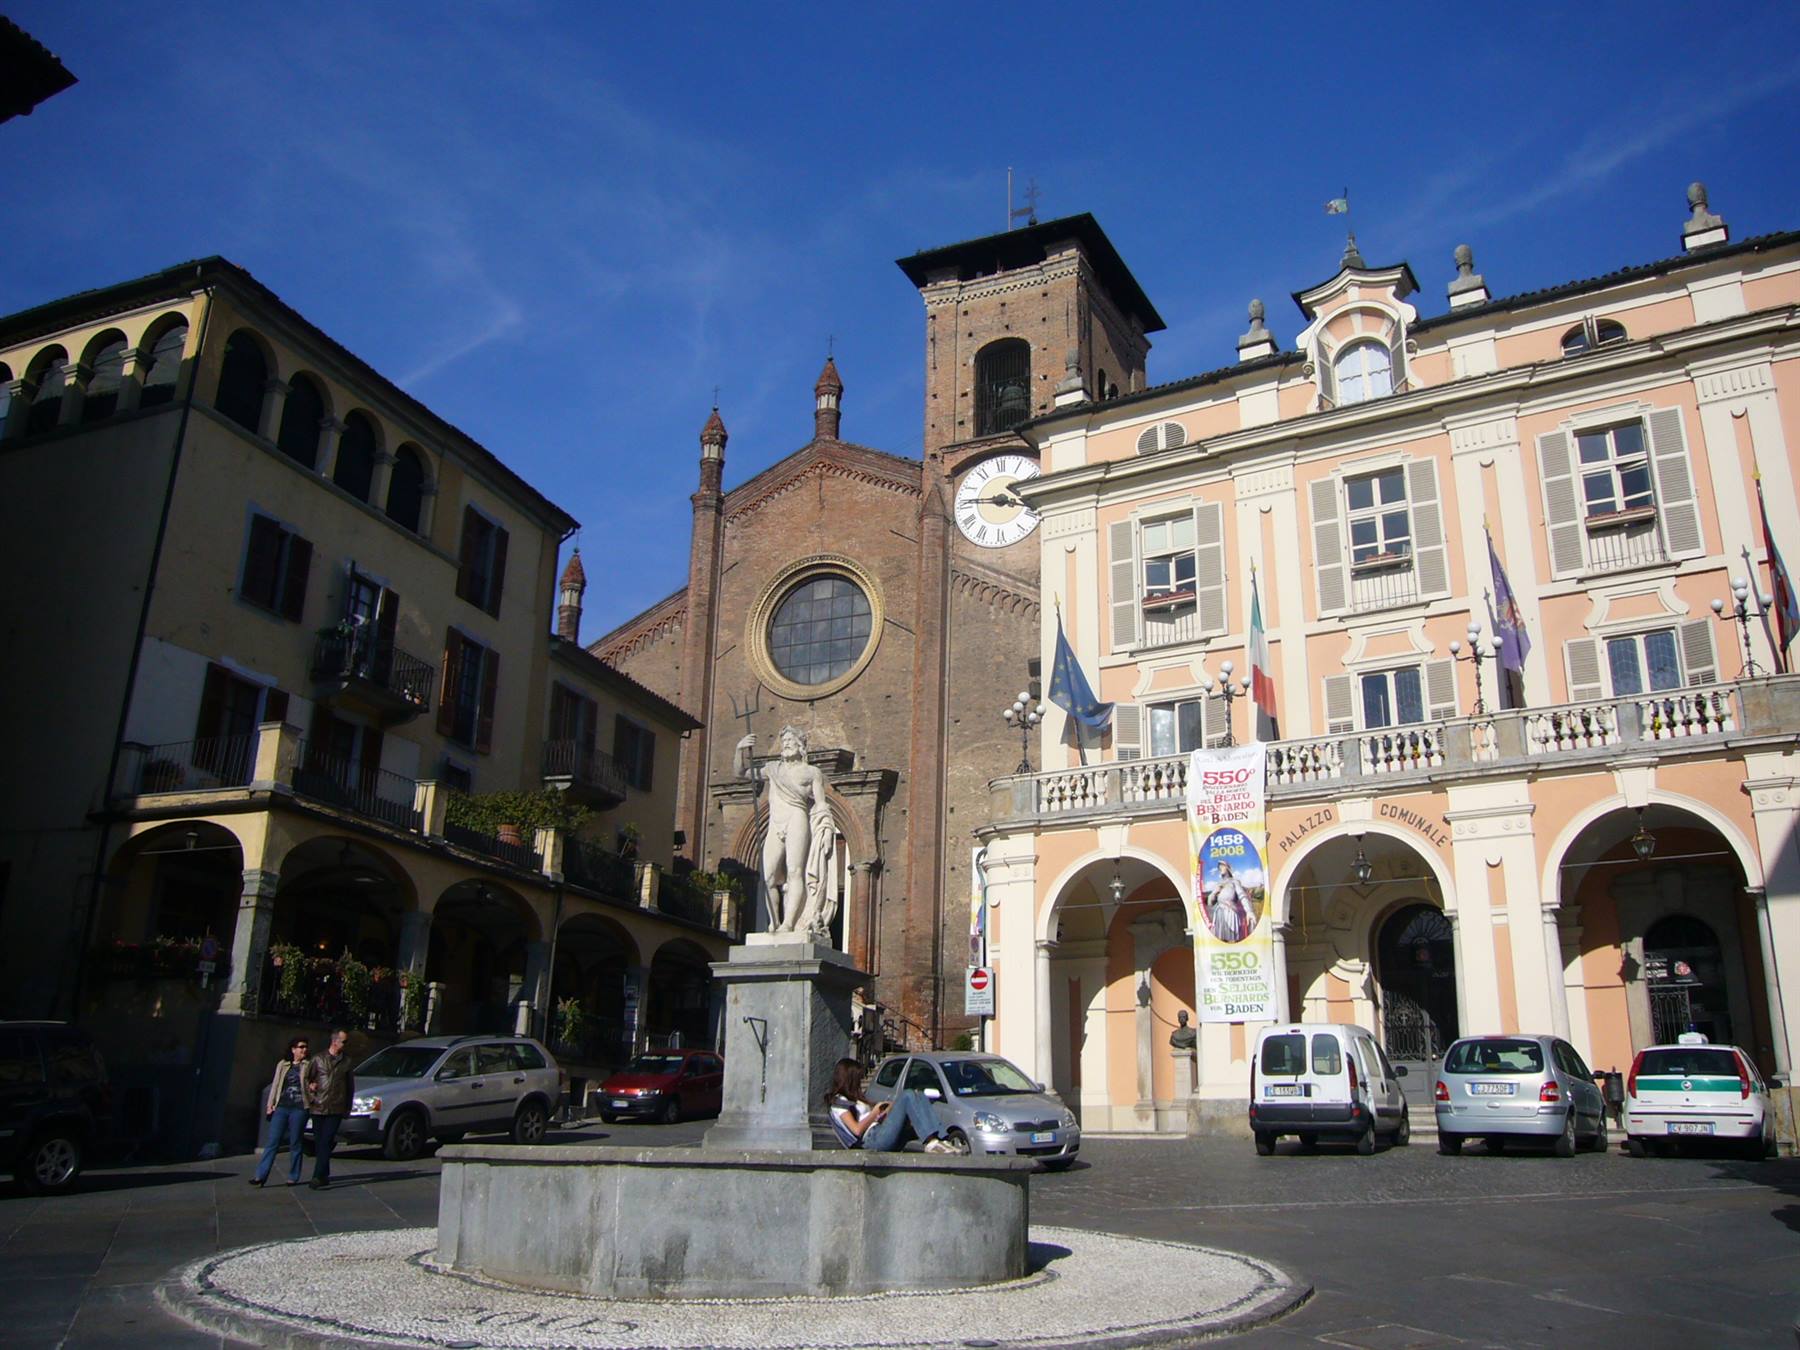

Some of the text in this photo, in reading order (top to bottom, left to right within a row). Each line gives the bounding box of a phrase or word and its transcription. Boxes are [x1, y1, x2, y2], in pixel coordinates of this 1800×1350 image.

[1214, 792, 1250, 804] BEATO
[1211, 811, 1249, 824] BADEN
[1279, 803, 1448, 852] PALAZZO COMUNALE
[1209, 833, 1244, 847] 1458
[1210, 845, 1246, 858] 2008
[1218, 982, 1268, 993] SELIGEN
[1224, 1003, 1264, 1015] BADEN
